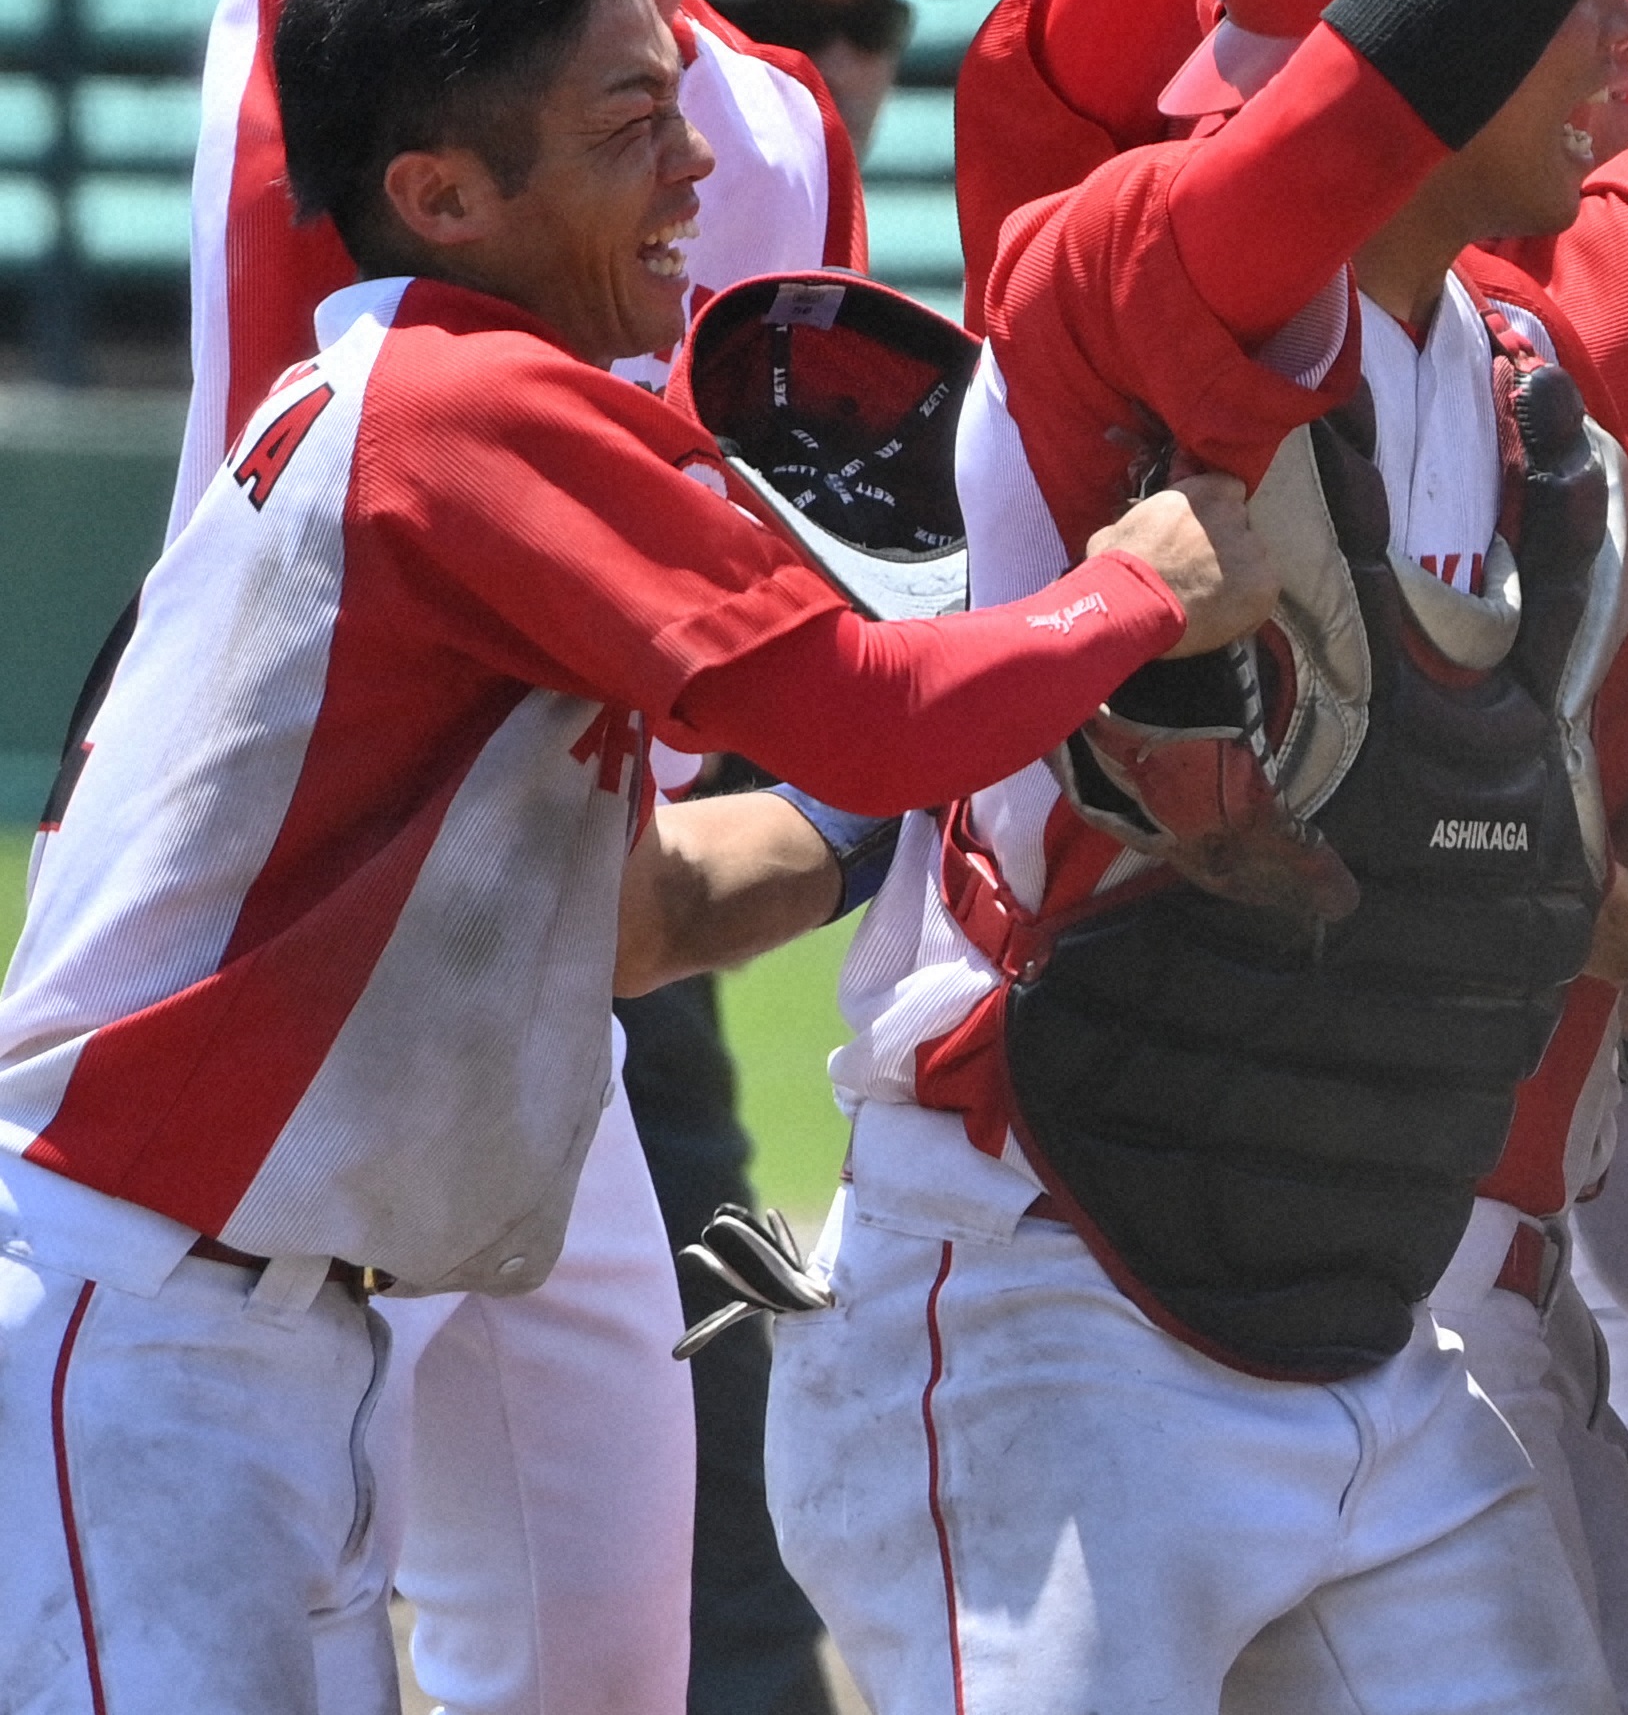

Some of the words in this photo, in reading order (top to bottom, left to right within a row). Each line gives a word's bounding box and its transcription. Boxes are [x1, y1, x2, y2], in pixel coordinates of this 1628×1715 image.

[774, 366, 789, 407] ZETT
[919, 382, 950, 418] ZETT
[855, 482, 896, 507] ZETT
[1430, 818, 1528, 852] ASHIKAGA
